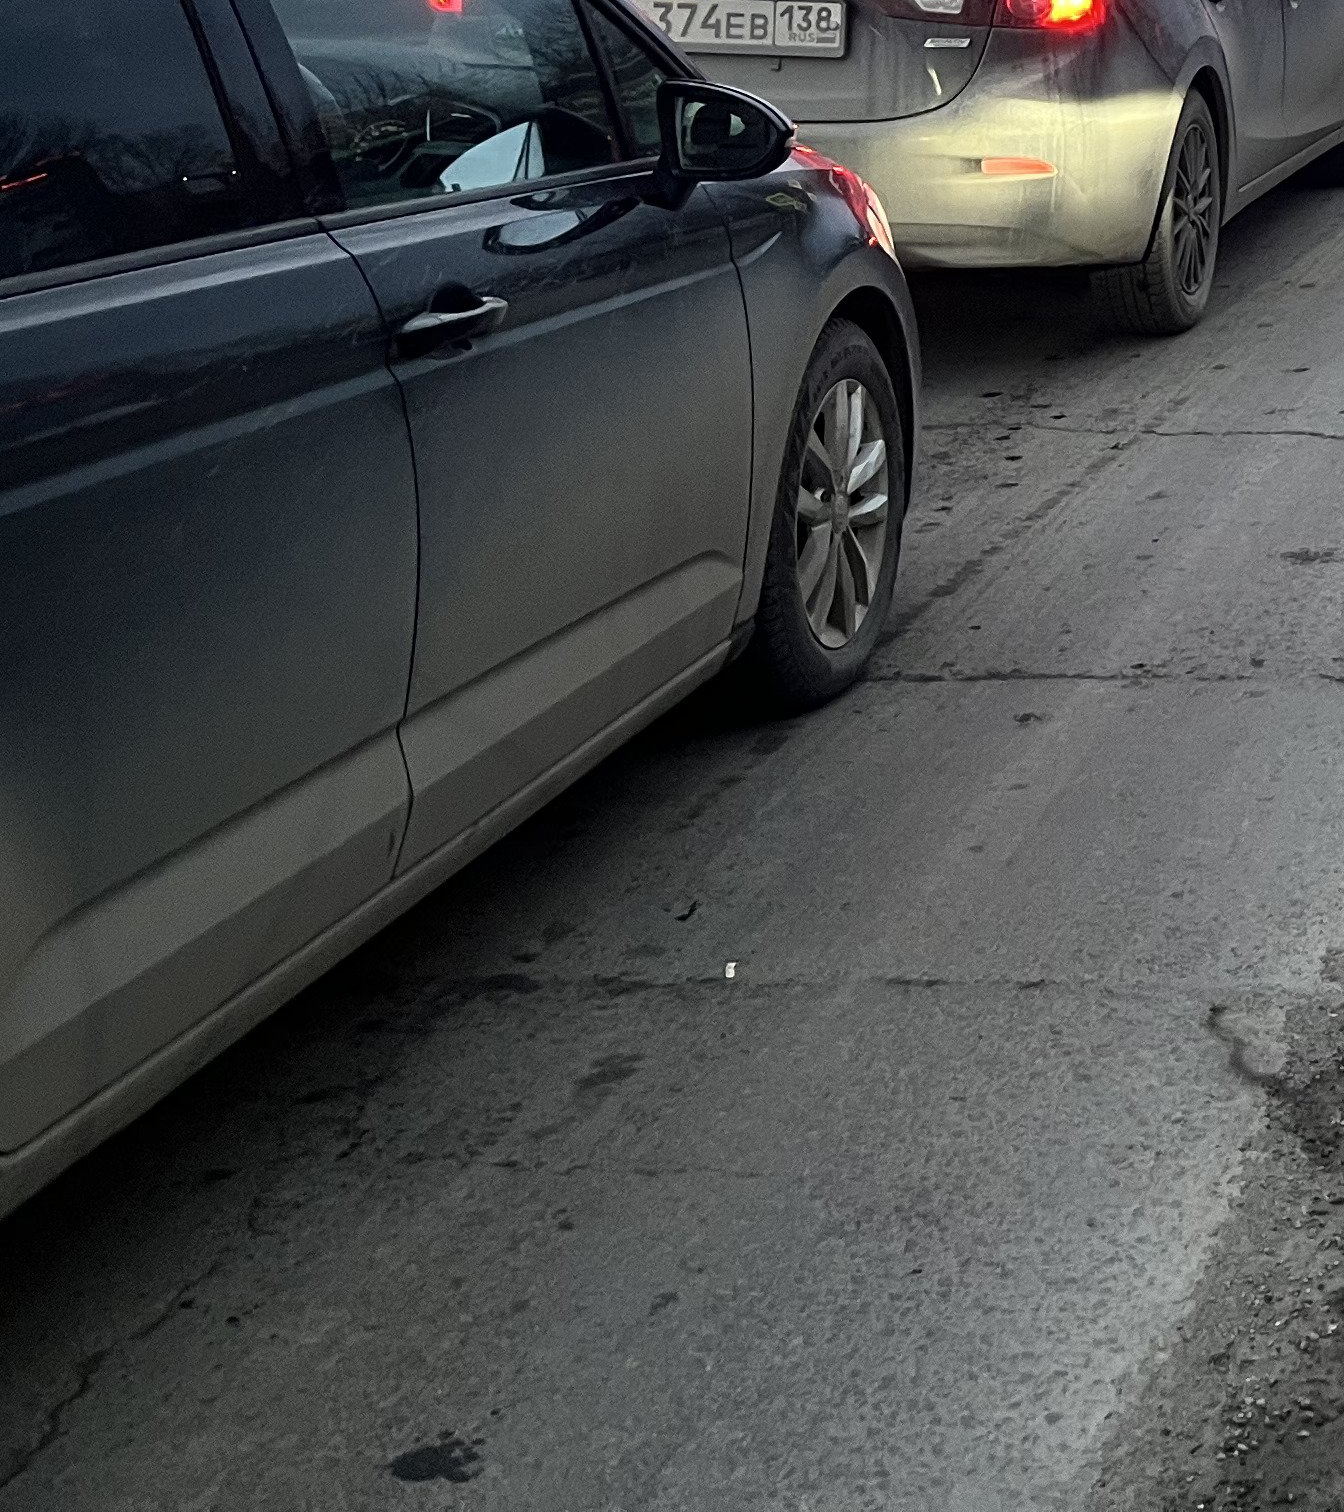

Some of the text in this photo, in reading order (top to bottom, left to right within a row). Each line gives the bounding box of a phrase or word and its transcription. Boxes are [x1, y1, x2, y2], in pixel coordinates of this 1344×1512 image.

[653, 1, 833, 39] 374ЕВ 138
[788, 32, 816, 43] RUS
